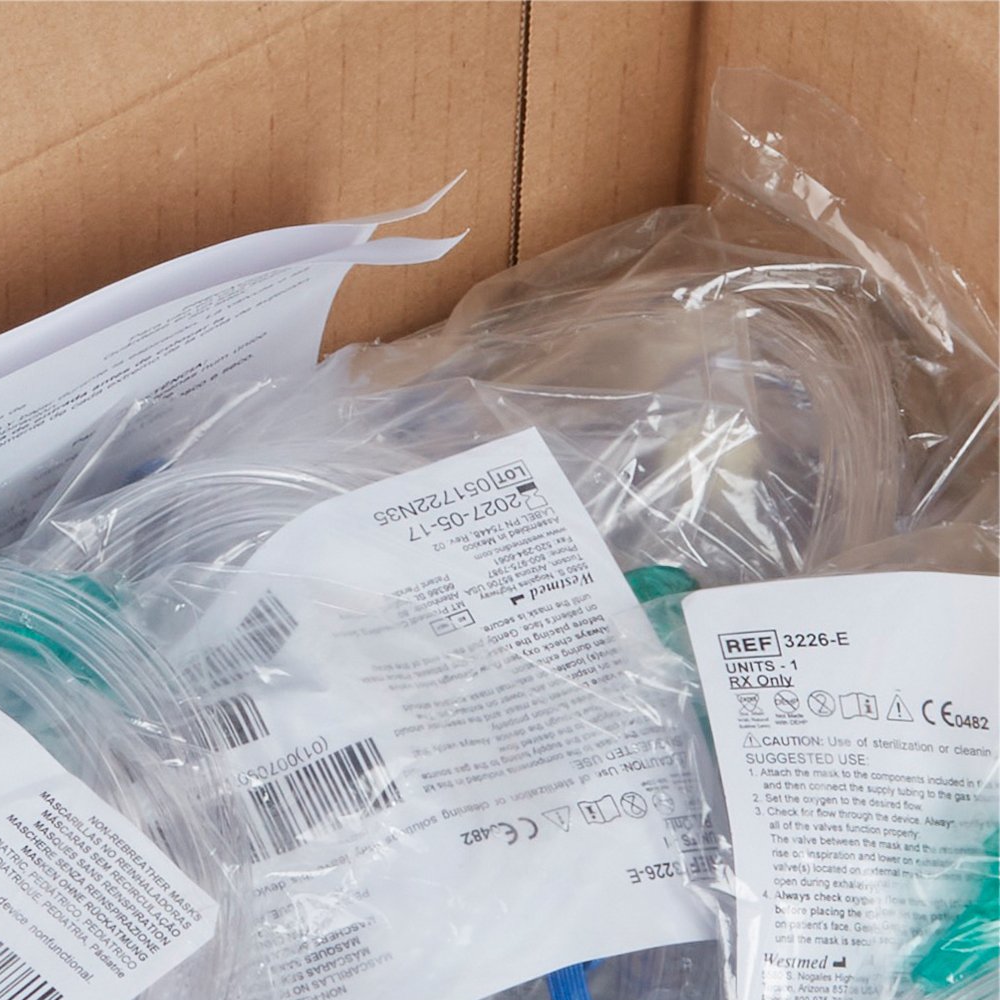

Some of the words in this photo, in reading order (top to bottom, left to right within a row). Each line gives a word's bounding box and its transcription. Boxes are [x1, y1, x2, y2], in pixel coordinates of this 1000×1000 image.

[493, 463, 527, 488] LOT
[371, 474, 491, 528] 051722N35
[405, 491, 521, 542] 2027-05-17
[507, 514, 560, 539] Assembled
[461, 535, 496, 553] Mexico
[463, 582, 485, 597] USA
[527, 569, 594, 601] Westmed
[726, 637, 773, 654] REF
[783, 631, 850, 648] 3226-E
[725, 660, 775, 674] UNITS
[729, 675, 752, 688] RX
[757, 673, 794, 690] Only
[955, 715, 990, 731] 0482
[762, 735, 824, 748] CAUTION:
[827, 736, 851, 748] Use
[856, 737, 867, 748] of
[872, 738, 934, 753] sterilization
[938, 744, 950, 754] or
[746, 752, 835, 766] SUGGESTED
[760, 768, 791, 778] Attach
[794, 768, 810, 779] the
[842, 770, 851, 780] to
[853, 770, 869, 781] the
[871, 770, 925, 785] components
[927, 774, 965, 788] included
[967, 776, 975, 788] in
[763, 780, 782, 791] and
[784, 780, 806, 792] then
[846, 782, 864, 794] the
[866, 784, 895, 800] supply
[897, 786, 925, 800] tubing
[927, 788, 935, 798] to
[938, 789, 953, 800] the
[955, 792, 971, 803] gas
[765, 793, 781, 804] Set
[783, 793, 801, 805] the
[841, 795, 850, 806] to
[852, 795, 870, 807] the
[870, 797, 899, 810] desired
[767, 806, 797, 817] Check
[816, 807, 837, 819] flow
[839, 808, 873, 823] through
[875, 810, 890, 822] the
[31, 819, 78, 861] MASQUES
[74, 857, 103, 883] SANS
[37, 790, 103, 846] MASCARILLAS
[98, 843, 117, 859] NO
[113, 856, 193, 930] REINHALADORAS
[88, 851, 112, 872] SEM
[87, 814, 171, 892] NON-REBREATHER
[167, 889, 203, 923] MASKS
[4, 812, 58, 860] MASCHERE
[53, 857, 87, 887] SENZA
[83, 883, 160, 955] REINSPIRAZIONE
[19, 844, 60, 881] MASKEN
[56, 877, 86, 904] OHNE
[82, 899, 150, 963] RÜCKATMUNG
[80, 918, 139, 971] PEDIATRICO
